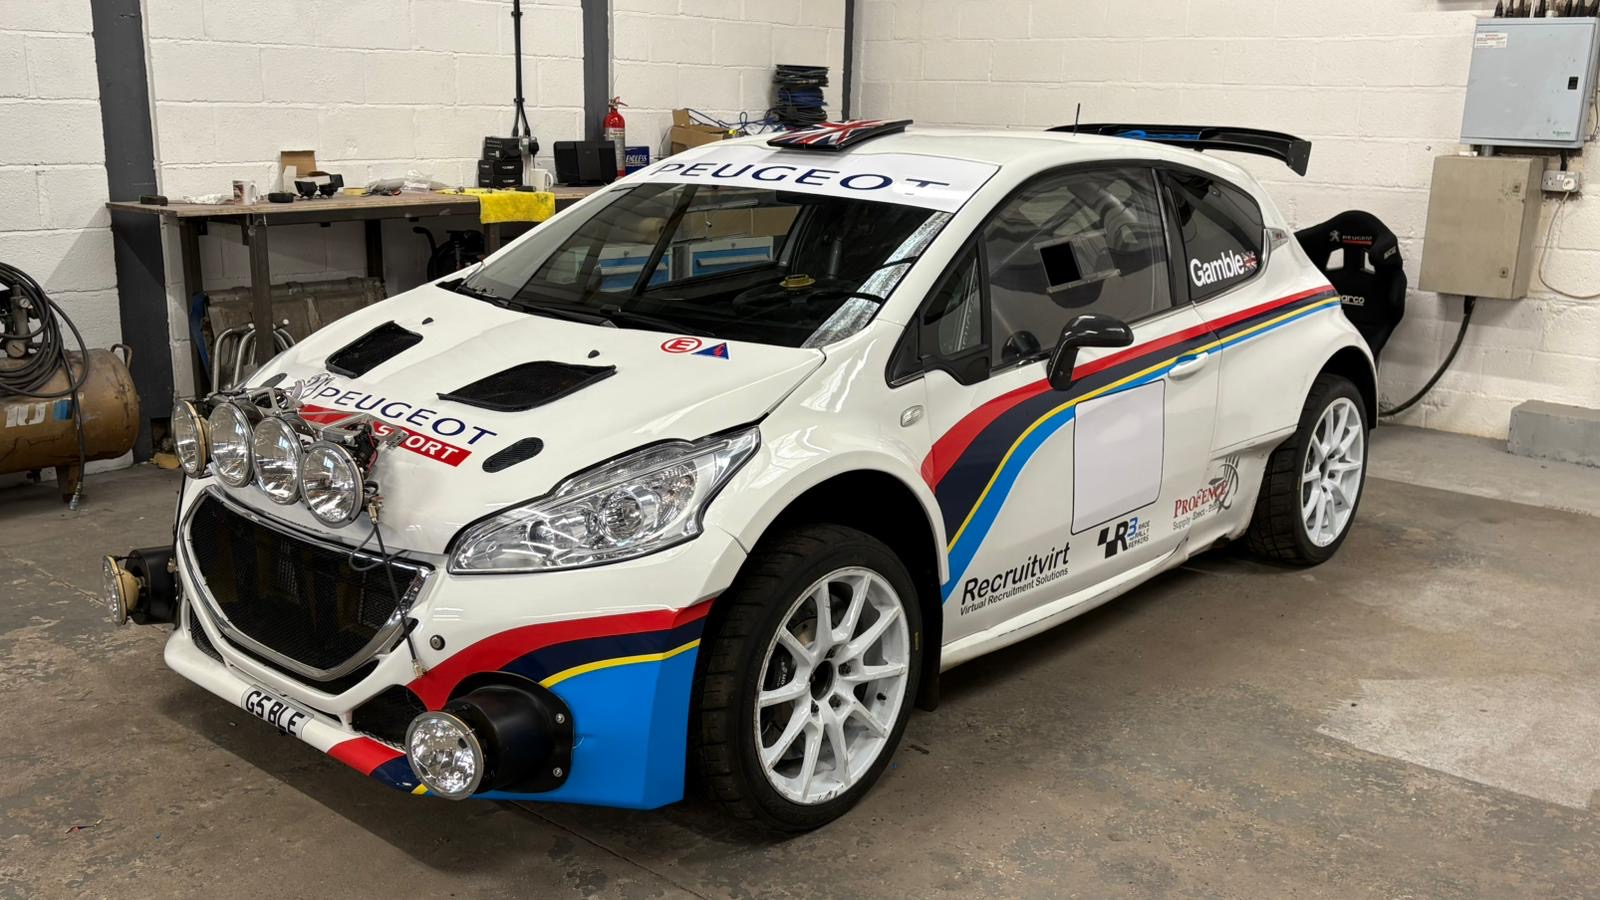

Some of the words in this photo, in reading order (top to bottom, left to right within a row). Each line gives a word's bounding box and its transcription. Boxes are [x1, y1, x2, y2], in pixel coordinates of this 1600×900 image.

[649, 162, 951, 196] PEUGEOT
[1190, 249, 1245, 287] Gamble
[1341, 295, 1365, 304] arco
[311, 386, 497, 445] PEUGEOT
[375, 424, 459, 460] SORT
[960, 598, 987, 616] Virtual
[987, 580, 1035, 605] Recruitment
[1036, 567, 1069, 587] Solutions
[961, 542, 1070, 605] Recruitvirt
